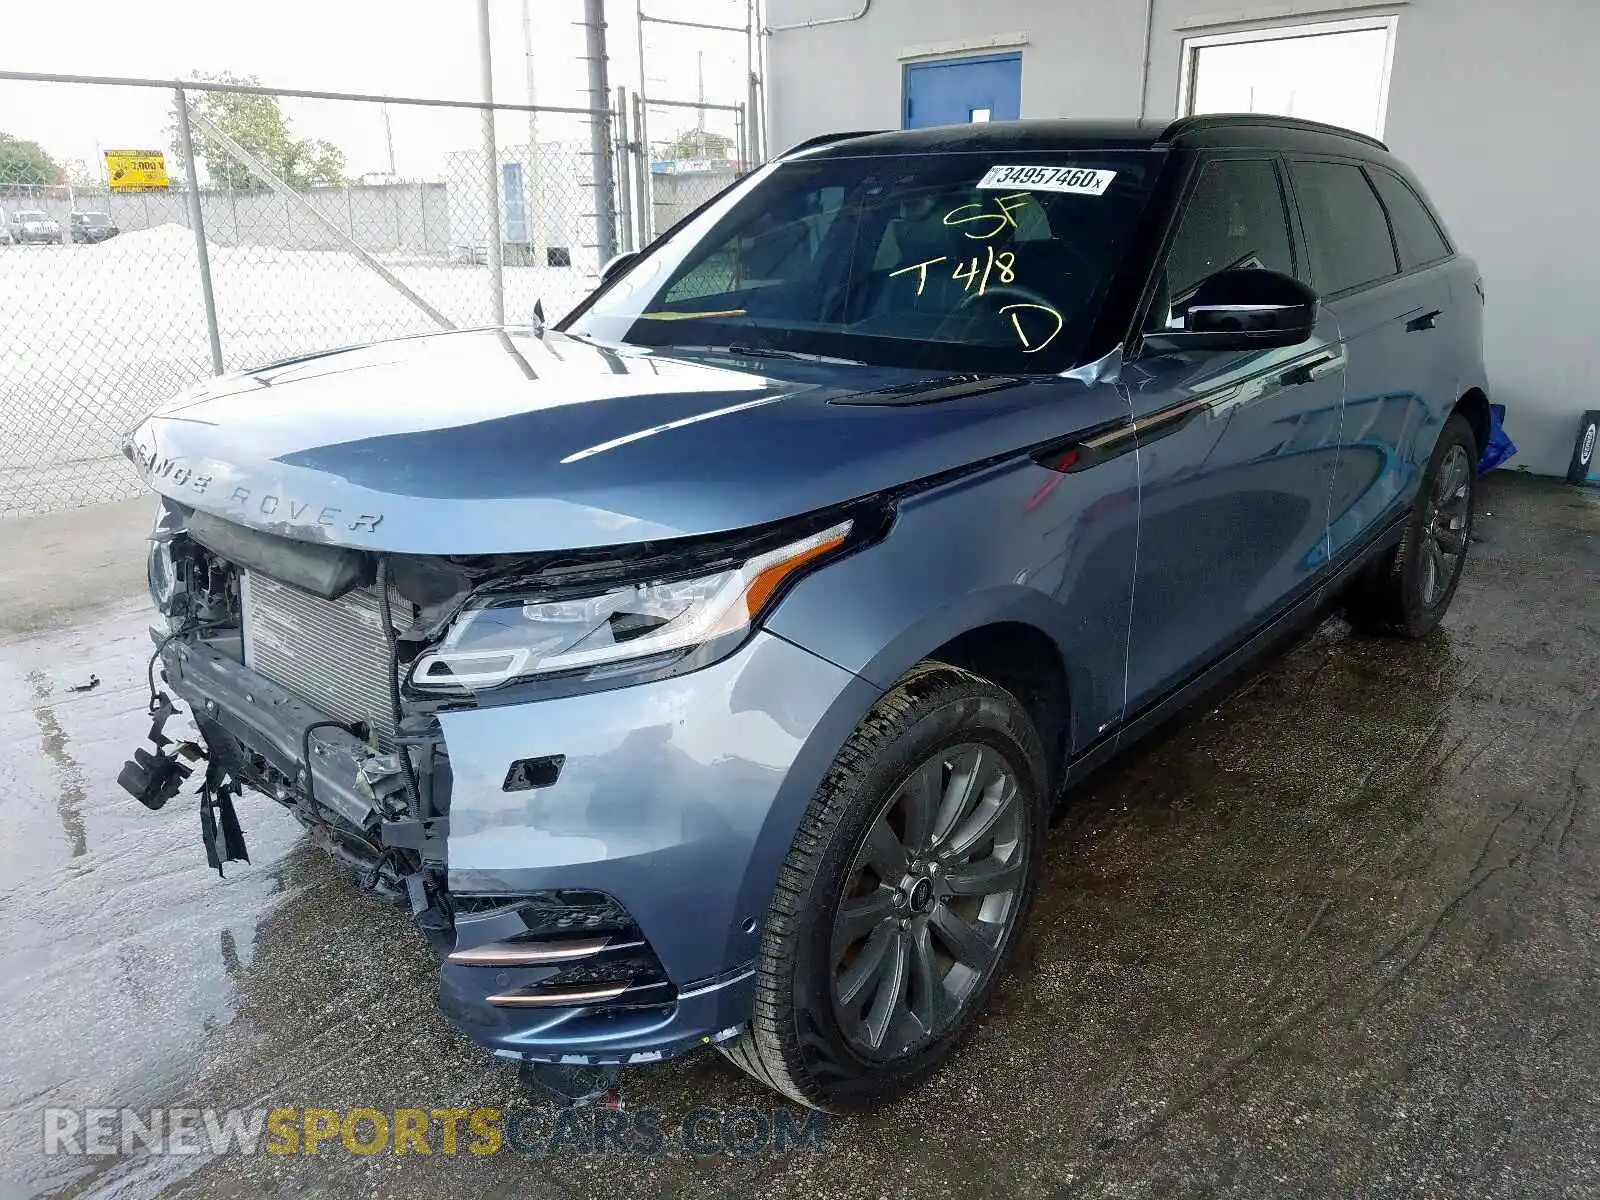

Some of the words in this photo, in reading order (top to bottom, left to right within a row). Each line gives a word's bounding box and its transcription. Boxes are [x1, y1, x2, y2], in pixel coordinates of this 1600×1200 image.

[944, 192, 1032, 239] SF
[889, 256, 947, 296] T
[952, 246, 1015, 296] 4/8
[999, 303, 1063, 353] D
[230, 486, 384, 533] ROVER
